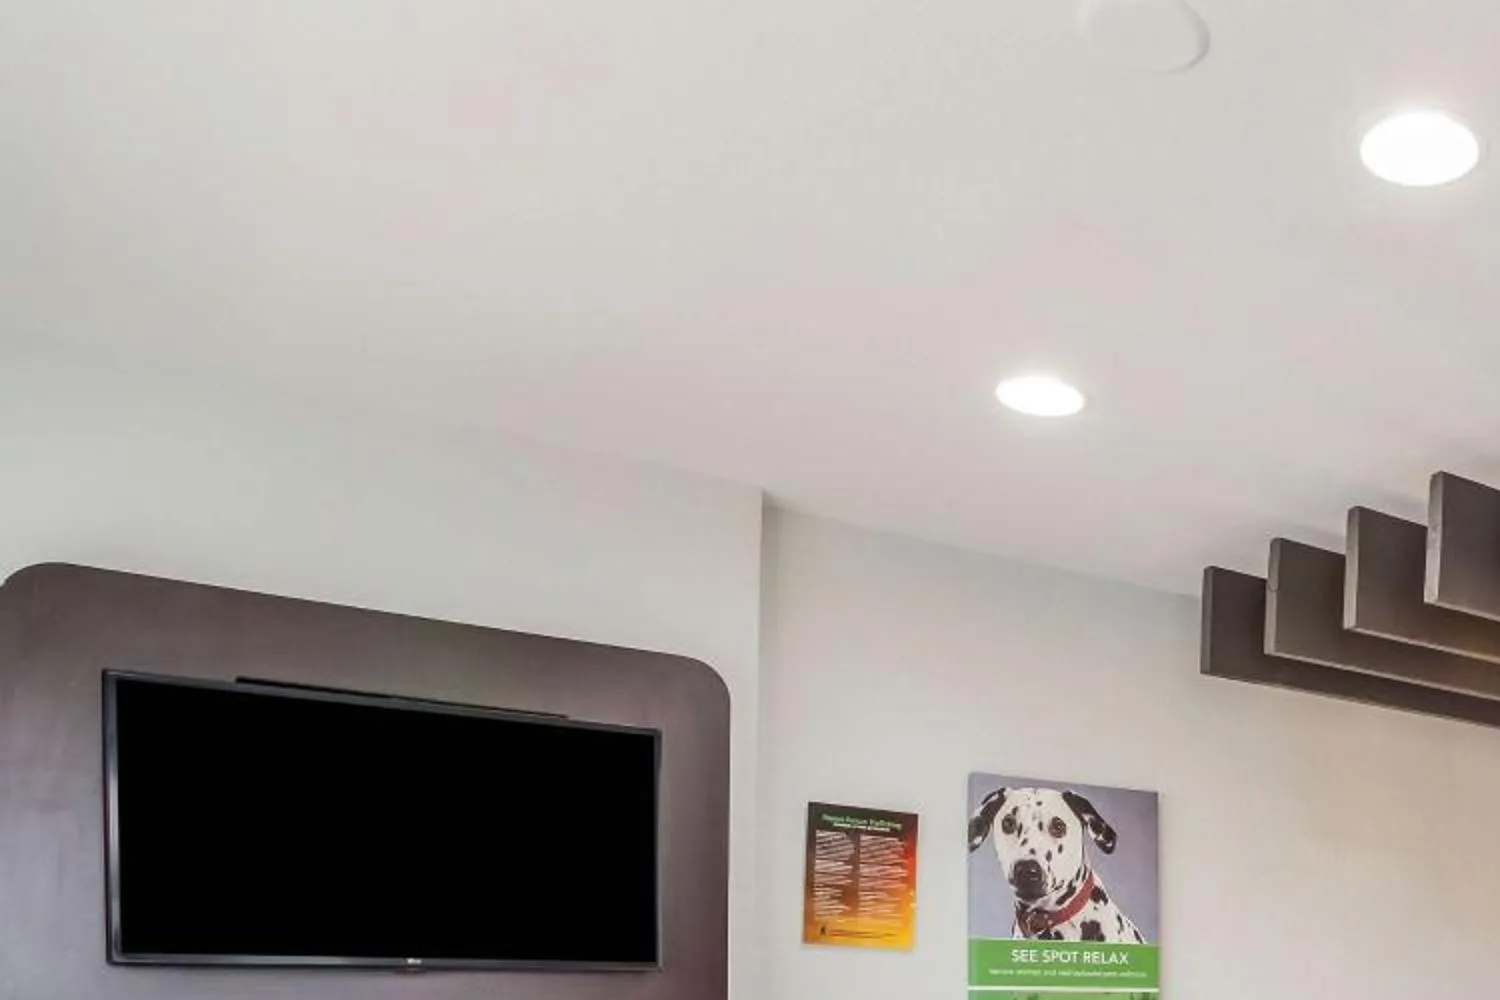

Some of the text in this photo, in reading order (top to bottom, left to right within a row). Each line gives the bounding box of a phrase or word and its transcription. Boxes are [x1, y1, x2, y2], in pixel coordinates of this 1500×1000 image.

[1011, 949, 1129, 965] SEE SPOT RELAX
